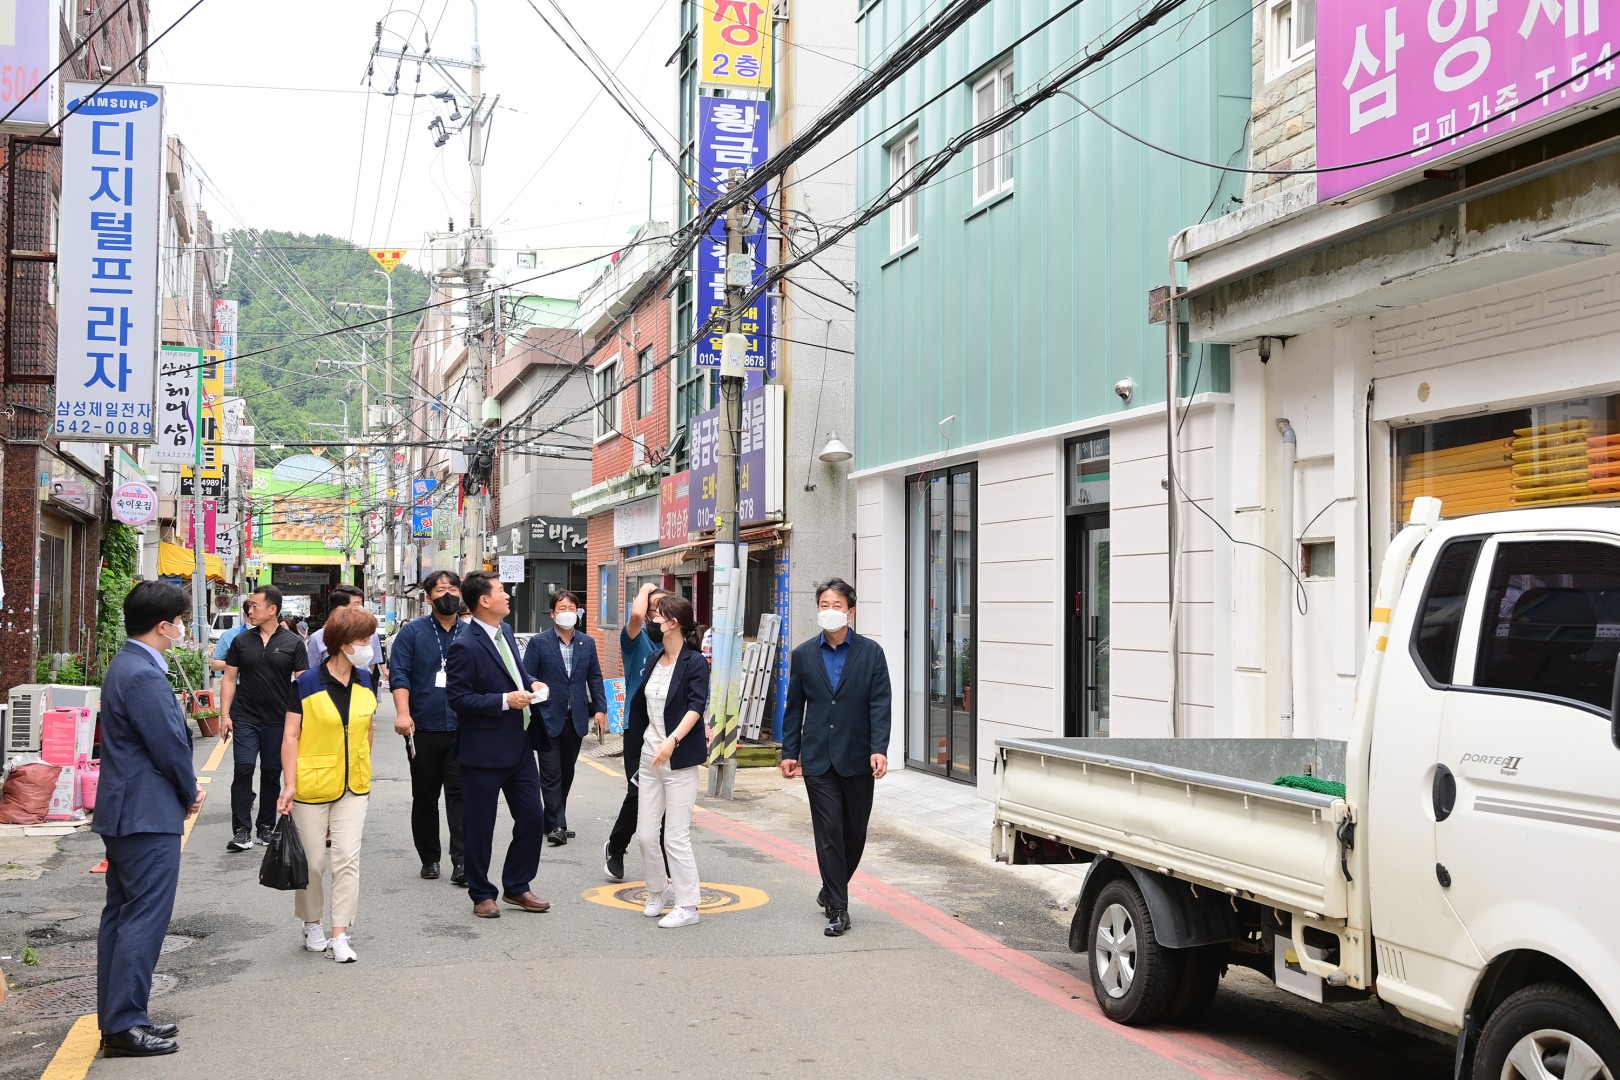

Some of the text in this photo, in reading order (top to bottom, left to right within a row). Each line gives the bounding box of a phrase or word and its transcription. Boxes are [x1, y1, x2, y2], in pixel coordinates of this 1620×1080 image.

[712, 53, 760, 79] 2층
[78, 97, 149, 110] SAMSUNG
[83, 120, 135, 393] 디지털프라자
[56, 400, 152, 420] 삼성제일전자
[55, 419, 152, 436] 542-0089
[116, 499, 152, 511] 숙이옷집
[1500, 768, 1518, 777] Super
